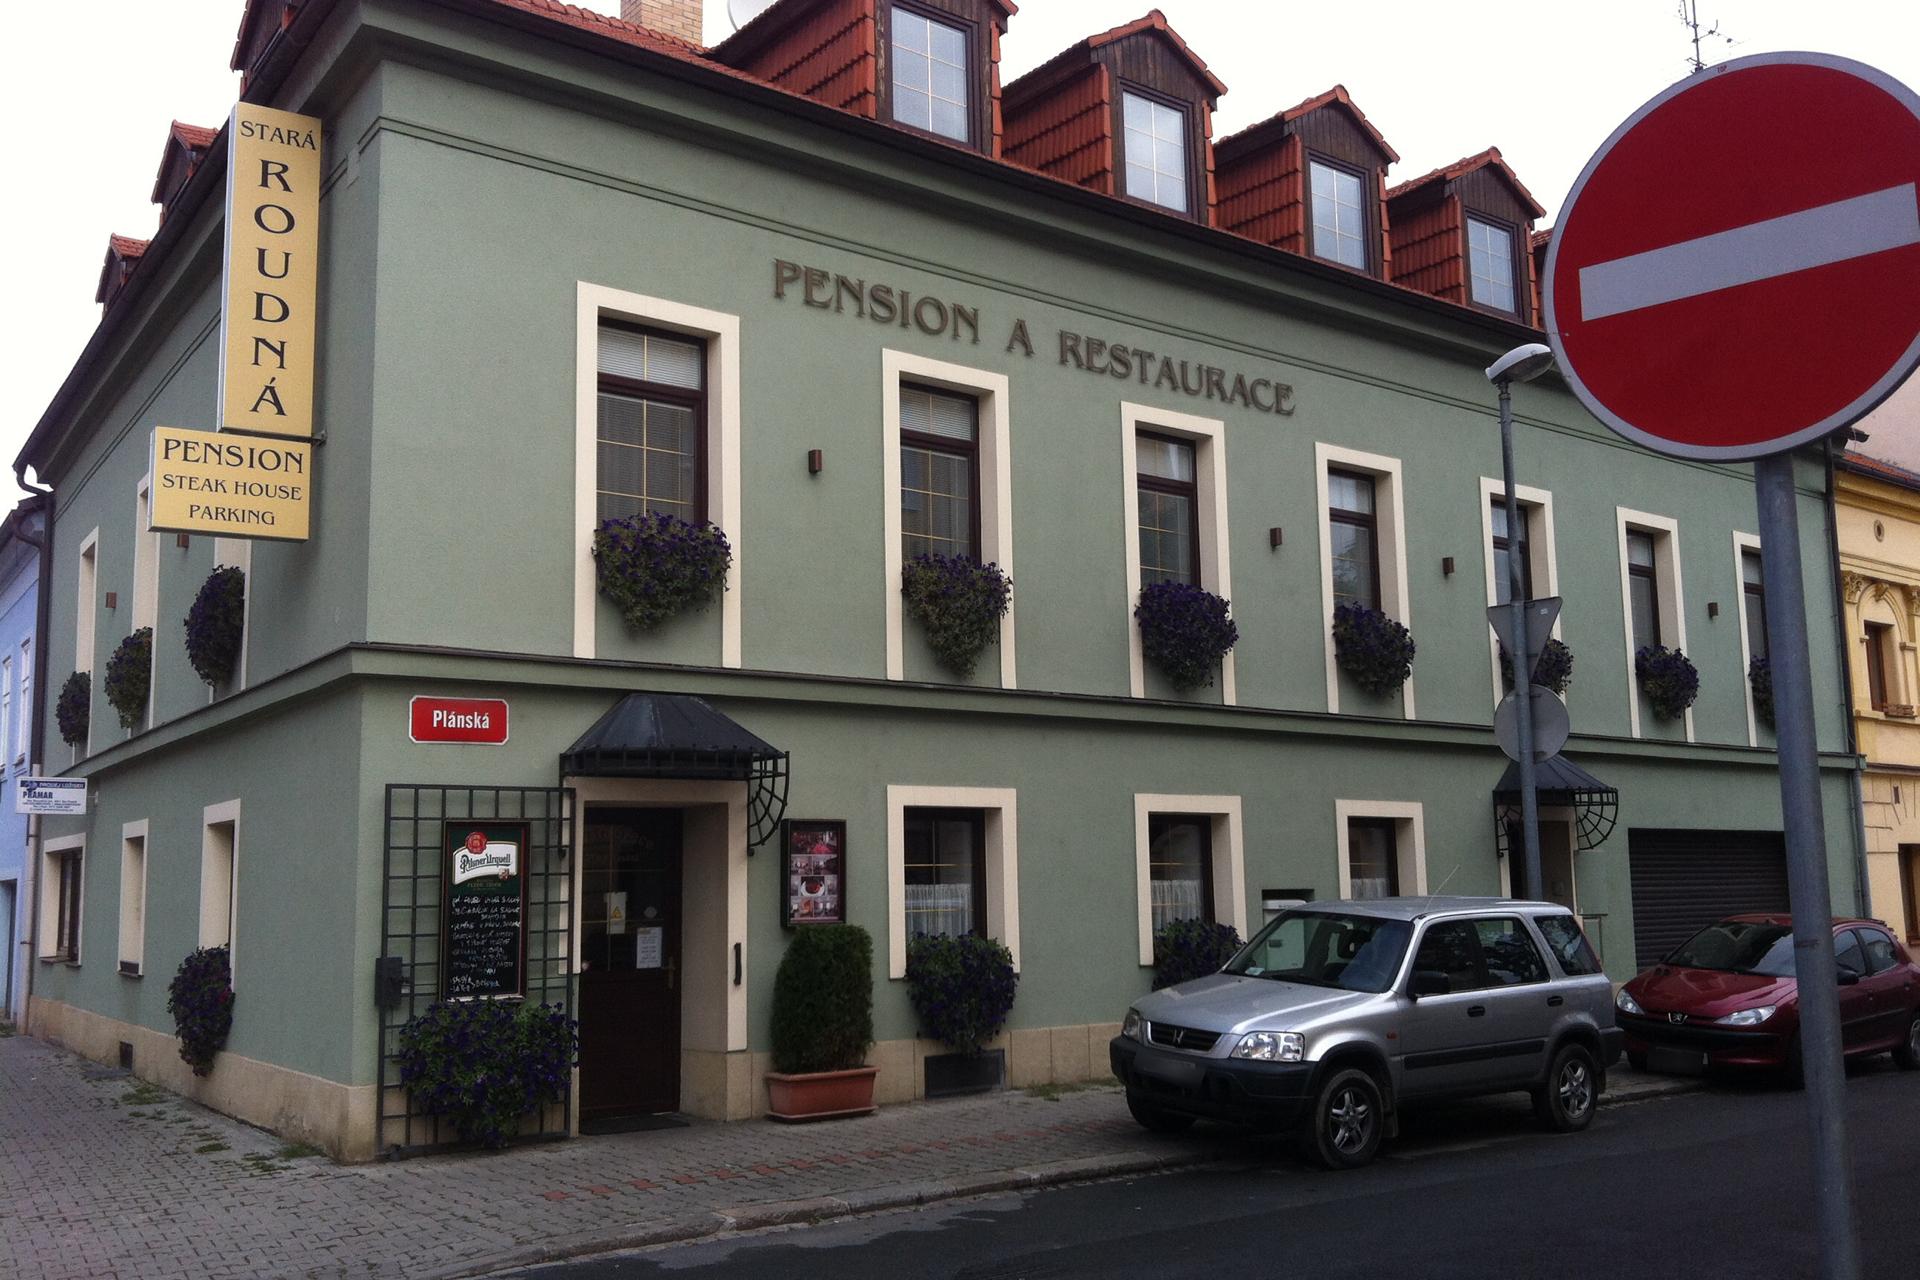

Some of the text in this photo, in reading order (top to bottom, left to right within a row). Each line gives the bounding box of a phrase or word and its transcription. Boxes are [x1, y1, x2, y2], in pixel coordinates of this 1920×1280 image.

[240, 120, 317, 151] STARÁ
[249, 158, 296, 417] ROUDNÁ
[772, 257, 1298, 417] PENSION A RESTAURACE
[163, 438, 304, 474] PENSION
[162, 473, 302, 501] STEAK HOUSE
[189, 504, 275, 526] PARKING
[432, 709, 490, 729] Plánská
[459, 853, 511, 874] Pilsner Urquell
